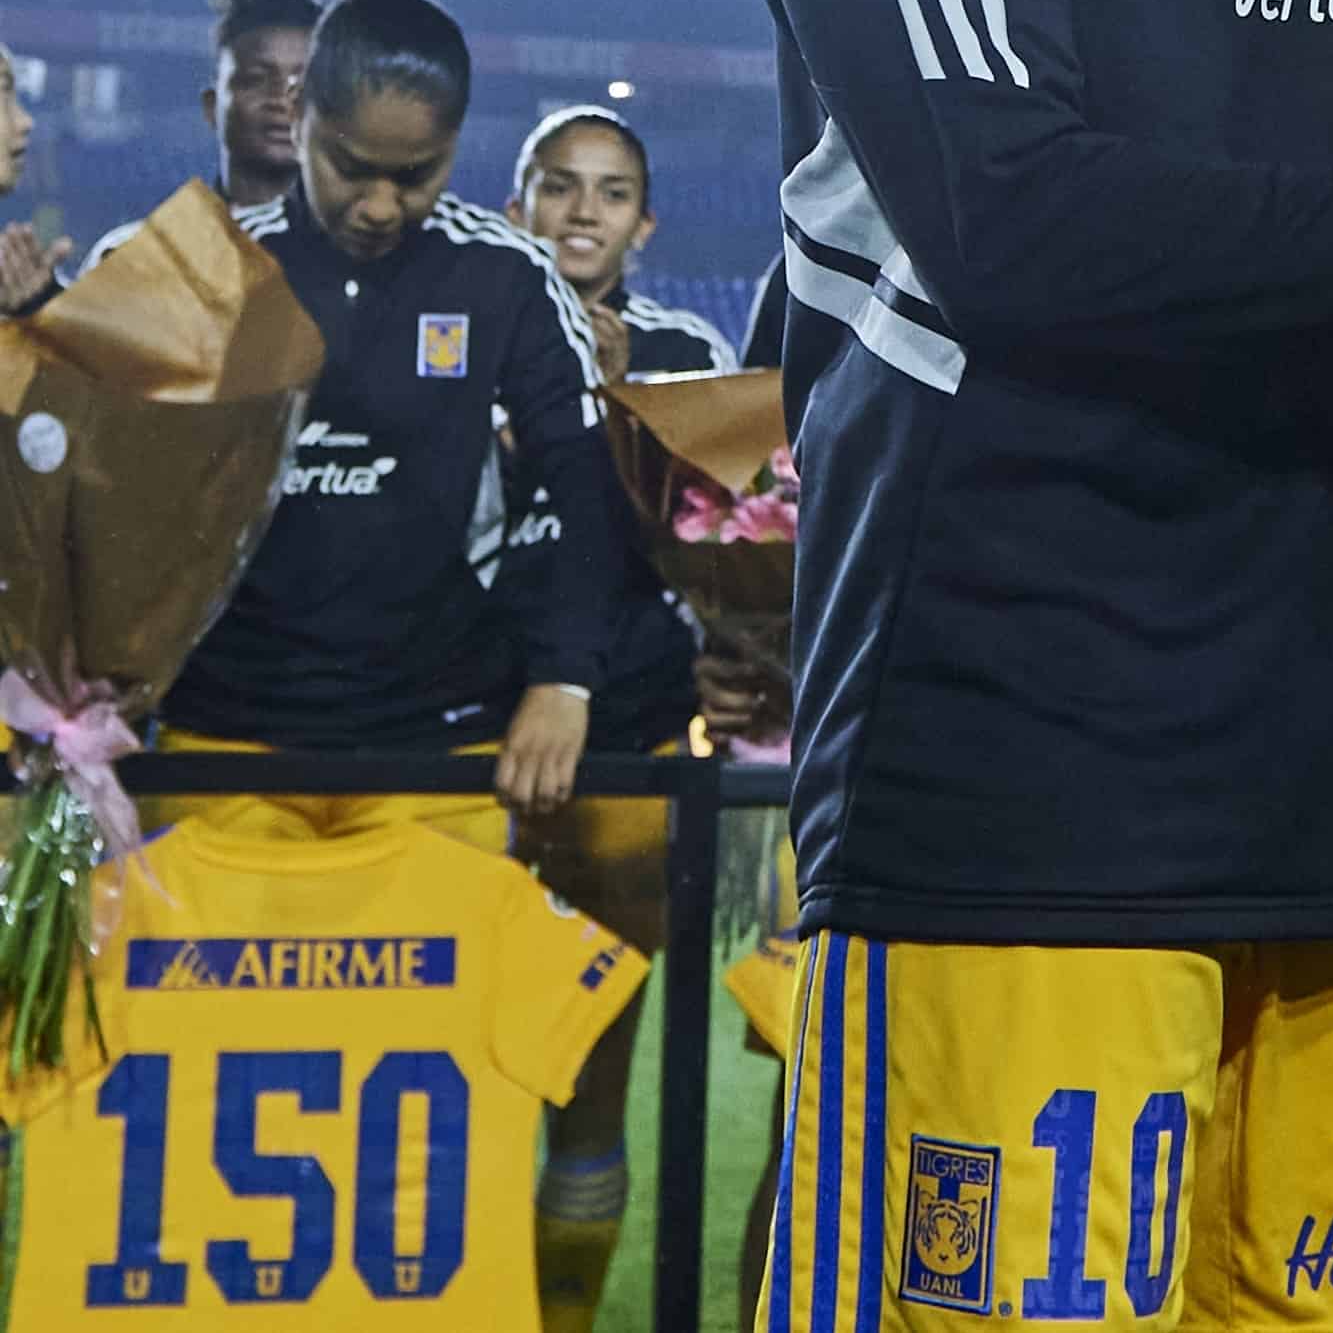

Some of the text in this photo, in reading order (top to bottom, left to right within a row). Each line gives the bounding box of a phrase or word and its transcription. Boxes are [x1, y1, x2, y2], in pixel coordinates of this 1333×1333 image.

[280, 457, 398, 496] ertua
[230, 939, 426, 989] AFIRME
[85, 1049, 470, 1308] 150
[916, 1147, 991, 1187] TIGRES
[1022, 1088, 1189, 1320] 10
[919, 1272, 965, 1299] UANL
